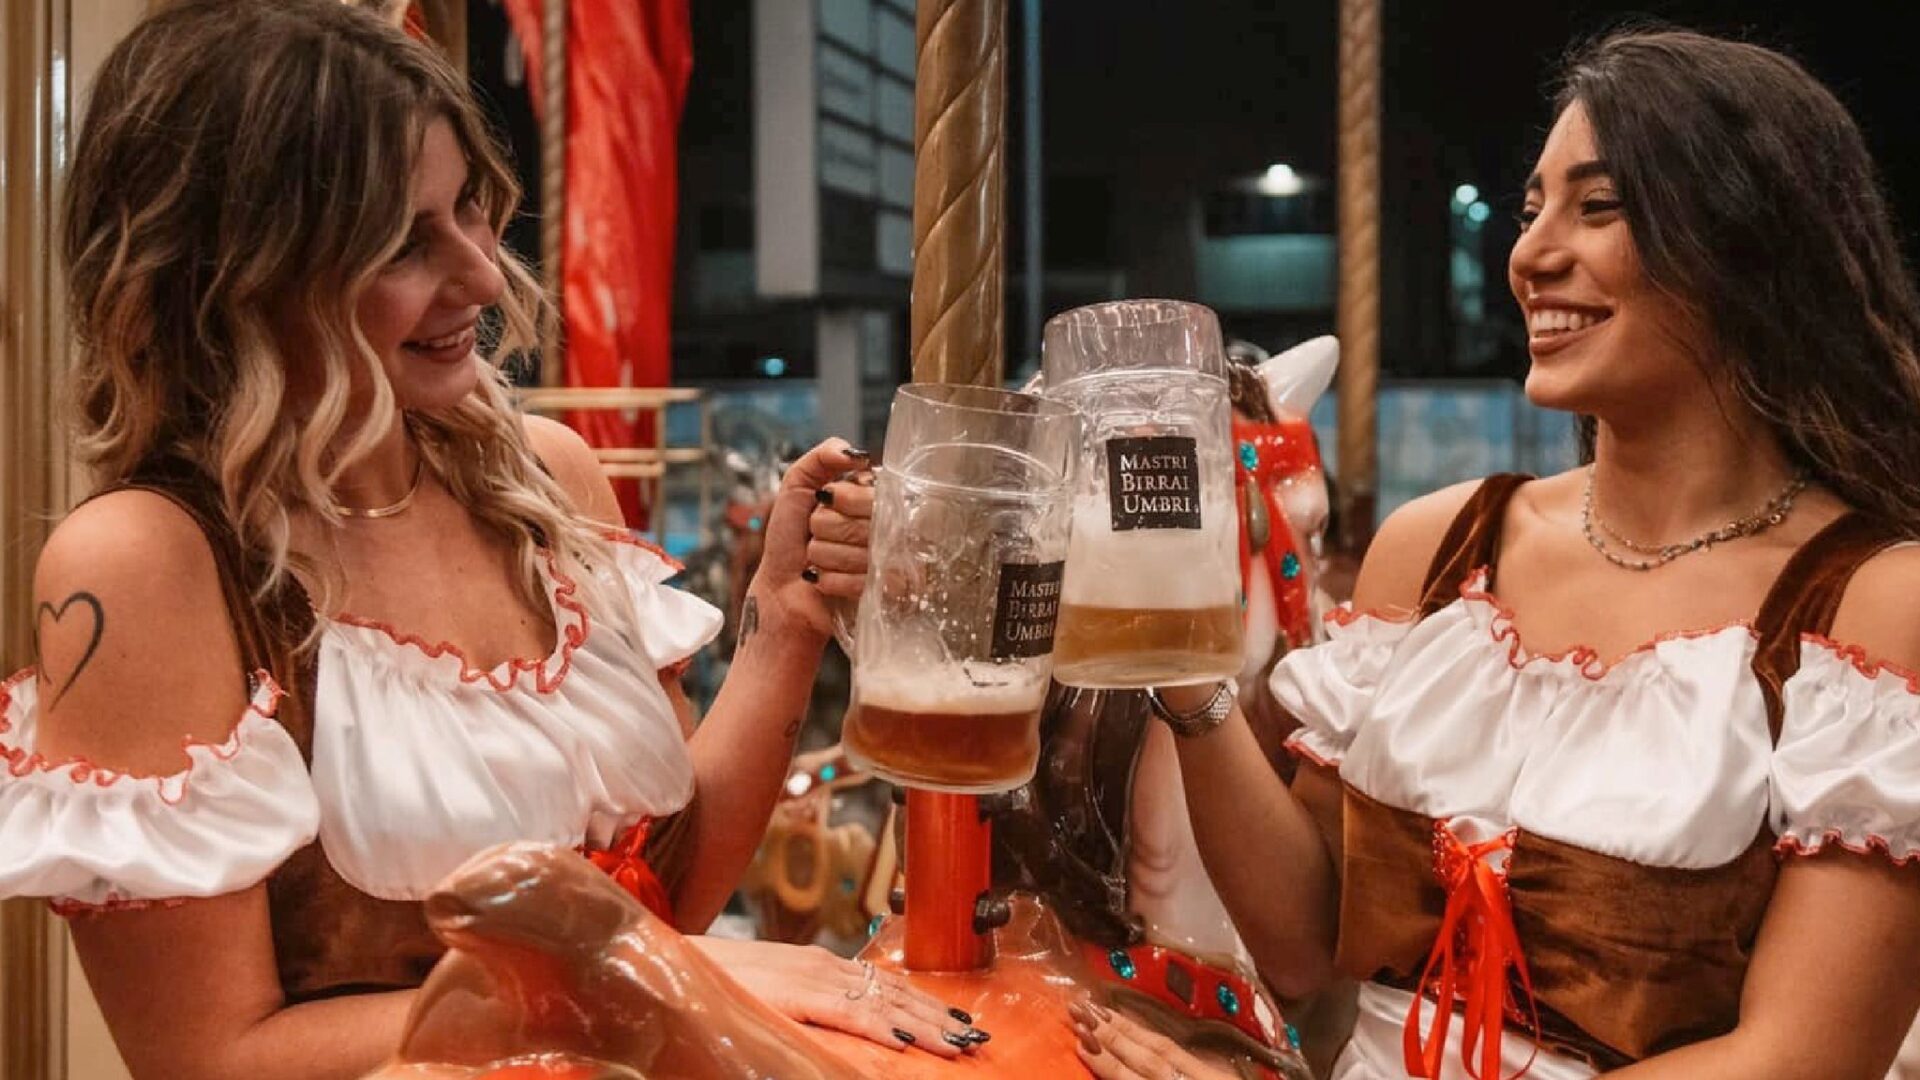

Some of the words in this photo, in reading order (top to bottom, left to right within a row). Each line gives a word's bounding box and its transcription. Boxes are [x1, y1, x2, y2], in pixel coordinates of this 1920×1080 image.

[1119, 454, 1187, 471] MASTRI
[1120, 473, 1190, 492] BIRRAI
[1123, 494, 1192, 513] UMBRI
